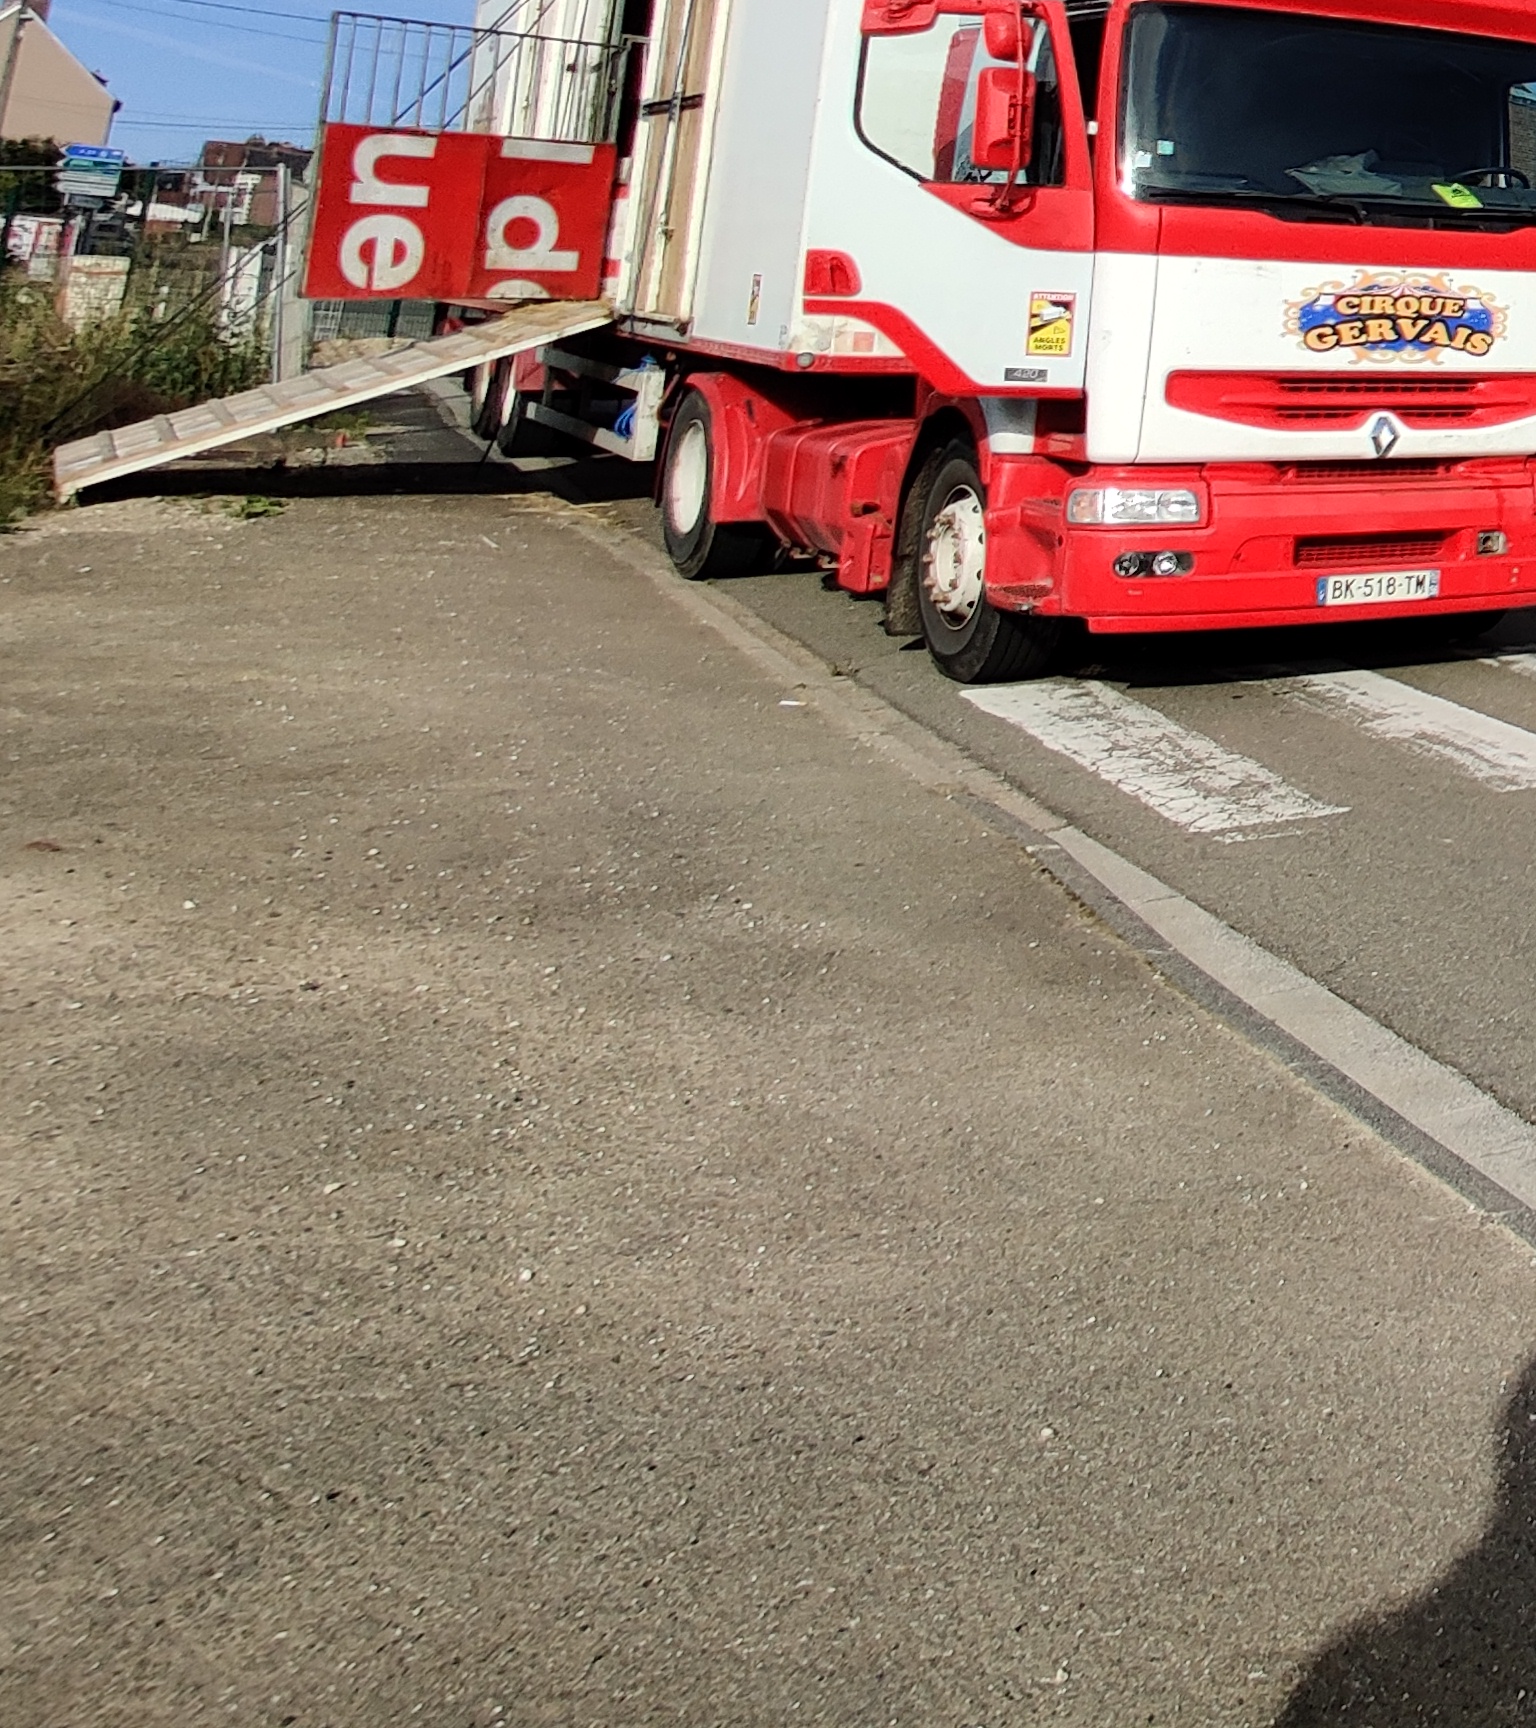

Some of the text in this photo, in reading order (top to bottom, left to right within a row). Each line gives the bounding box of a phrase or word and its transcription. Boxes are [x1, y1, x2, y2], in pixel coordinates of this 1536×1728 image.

[1335, 294, 1467, 319] CIRQUE
[1304, 317, 1494, 356] GERVAIS
[1013, 369, 1039, 378] 420
[1332, 575, 1426, 600] BK-518-TM
